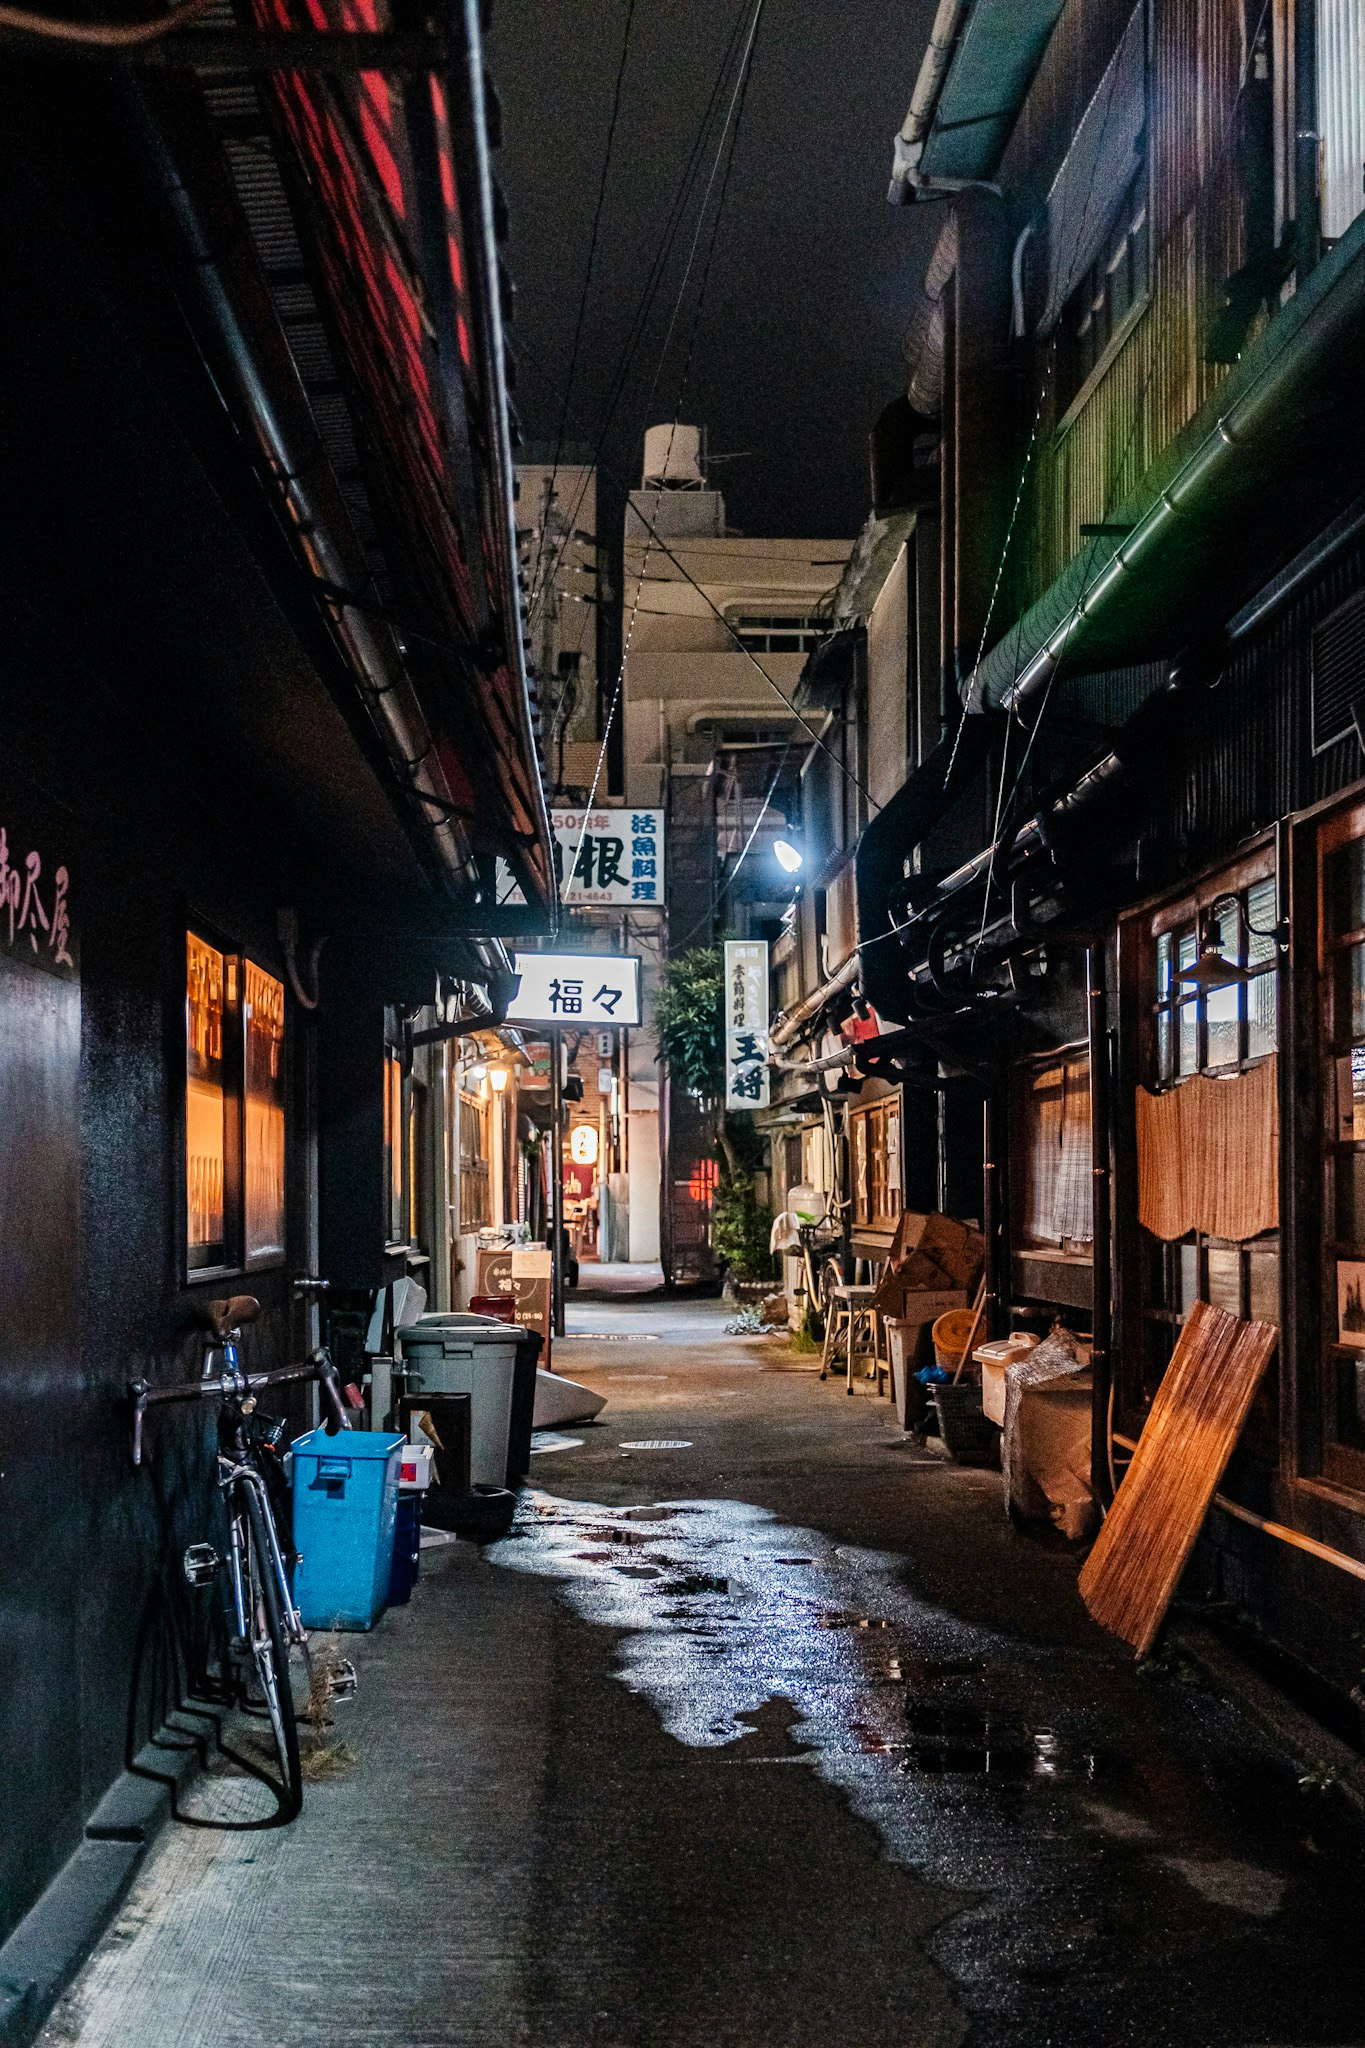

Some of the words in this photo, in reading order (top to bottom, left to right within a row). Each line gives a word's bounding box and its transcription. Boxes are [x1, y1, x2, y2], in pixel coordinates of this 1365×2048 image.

[553, 833, 630, 889] 根
[631, 814, 657, 900] 活魚料理
[548, 978, 623, 1015] 福々
[732, 964, 746, 1028] 季節料理
[731, 1033, 766, 1100] 王将
